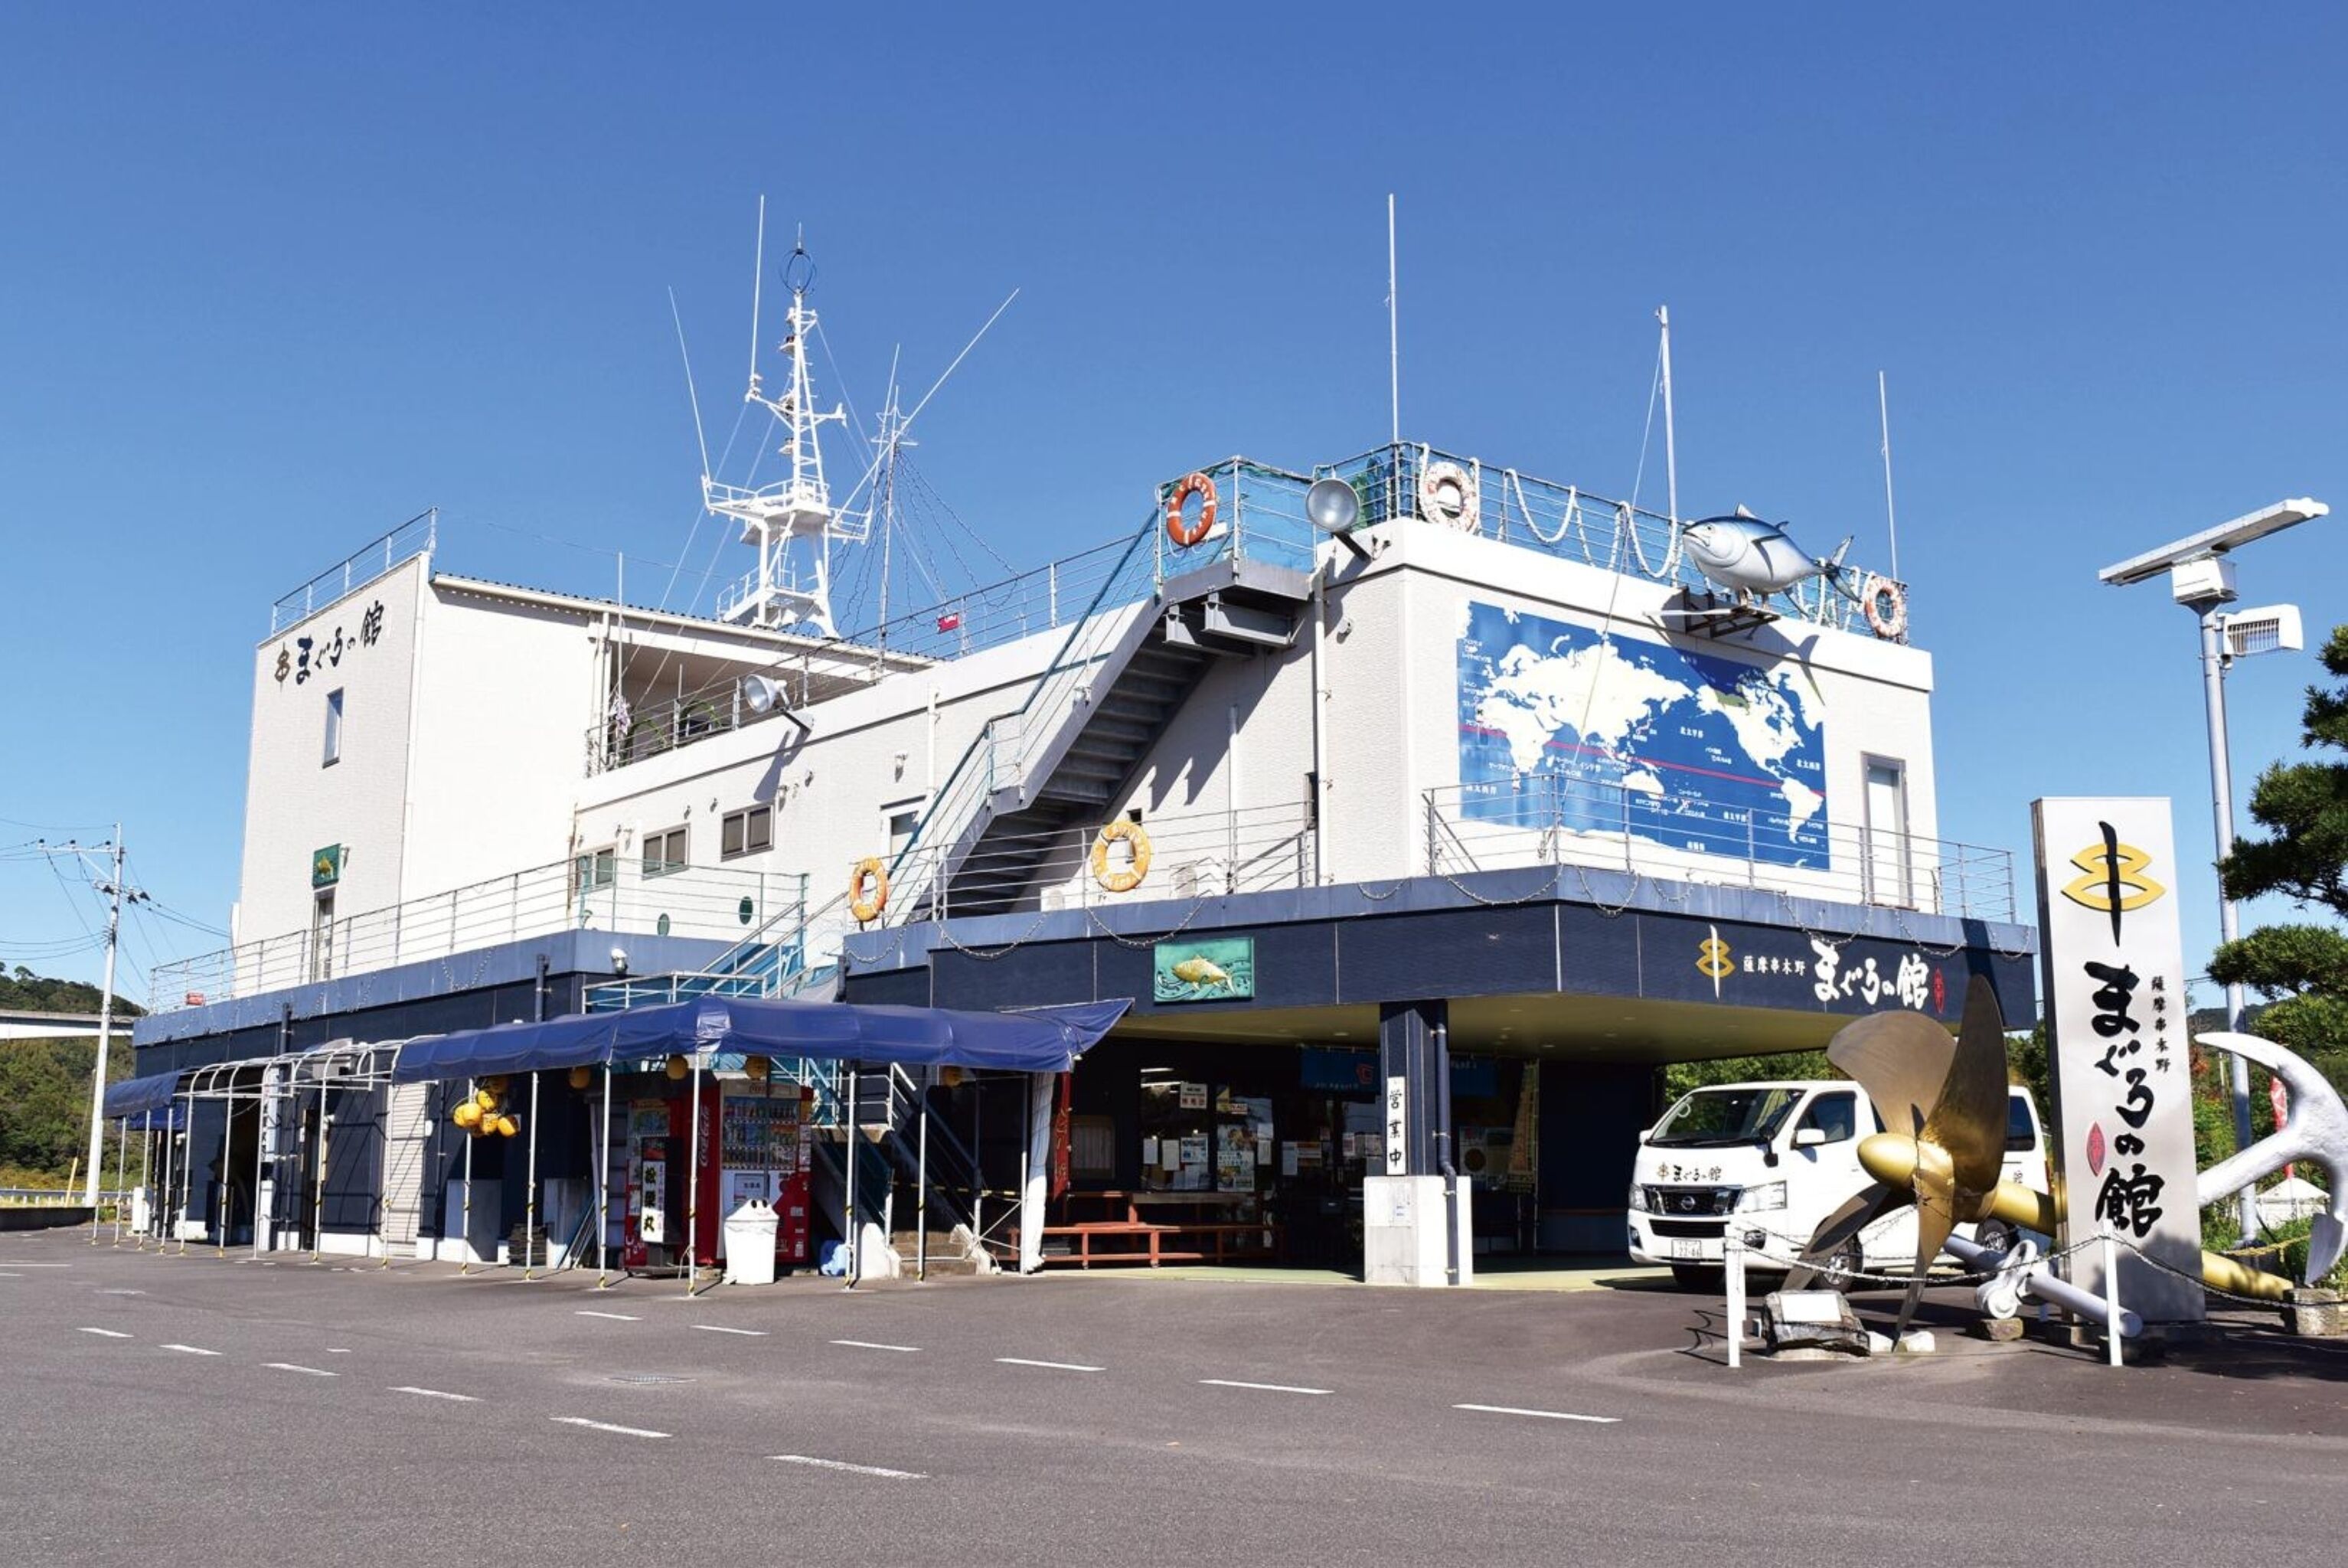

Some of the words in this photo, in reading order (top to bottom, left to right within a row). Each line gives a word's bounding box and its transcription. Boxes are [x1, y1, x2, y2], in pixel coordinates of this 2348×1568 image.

[296, 599, 384, 685] まぐろの館
[1810, 939, 1929, 1011] まぐろの館
[1389, 1089, 1403, 1167] 営業中
[2083, 960, 2166, 1239] まぐろの館
